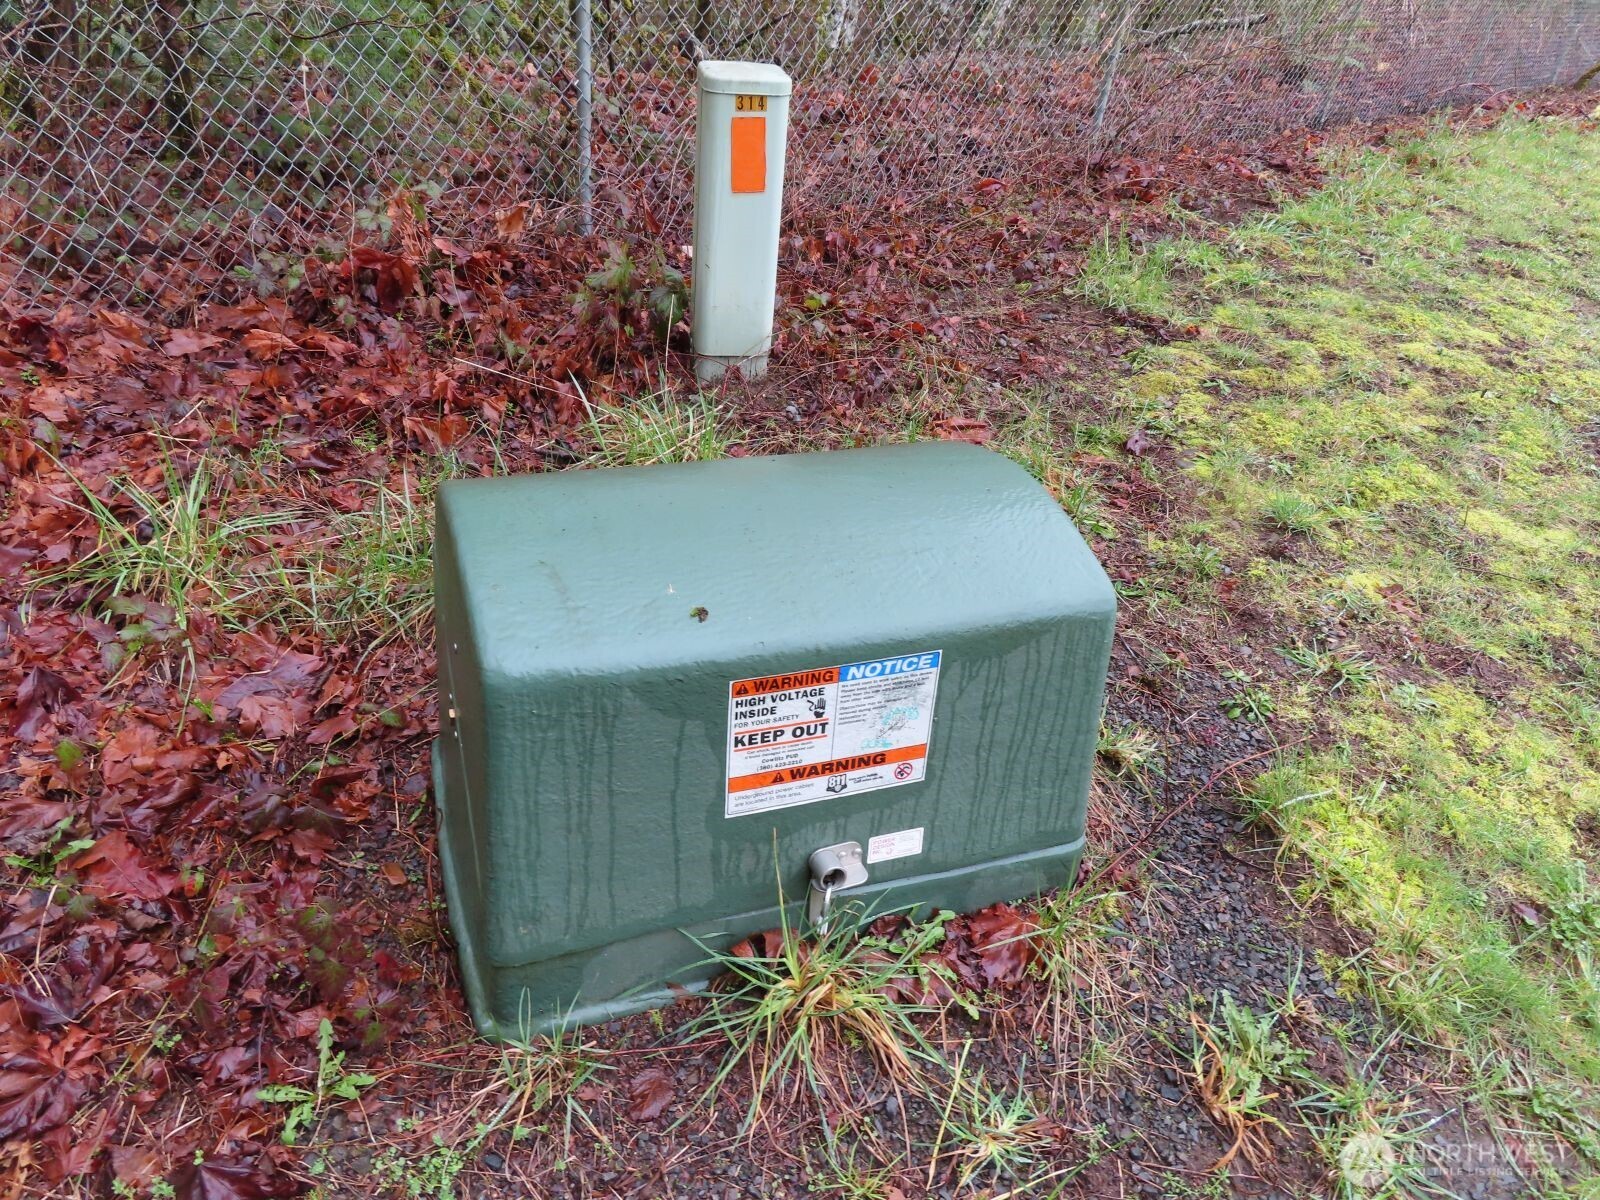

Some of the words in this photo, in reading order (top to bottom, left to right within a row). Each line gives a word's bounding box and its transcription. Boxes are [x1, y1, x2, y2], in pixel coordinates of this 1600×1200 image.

[737, 95, 764, 110] 314
[847, 654, 934, 680] NOTICE
[753, 670, 834, 692] WARNING
[735, 696, 766, 709] HIGH
[770, 687, 826, 703] VOLTAGE
[734, 706, 777, 720] INSIDE
[734, 721, 749, 729] FOR
[751, 719, 771, 727] YOUR
[772, 714, 800, 723] SAFETY
[734, 729, 785, 748] KEEP
[791, 722, 829, 739] OUT
[789, 753, 886, 779] WARNING
[828, 774, 847, 788] 811
